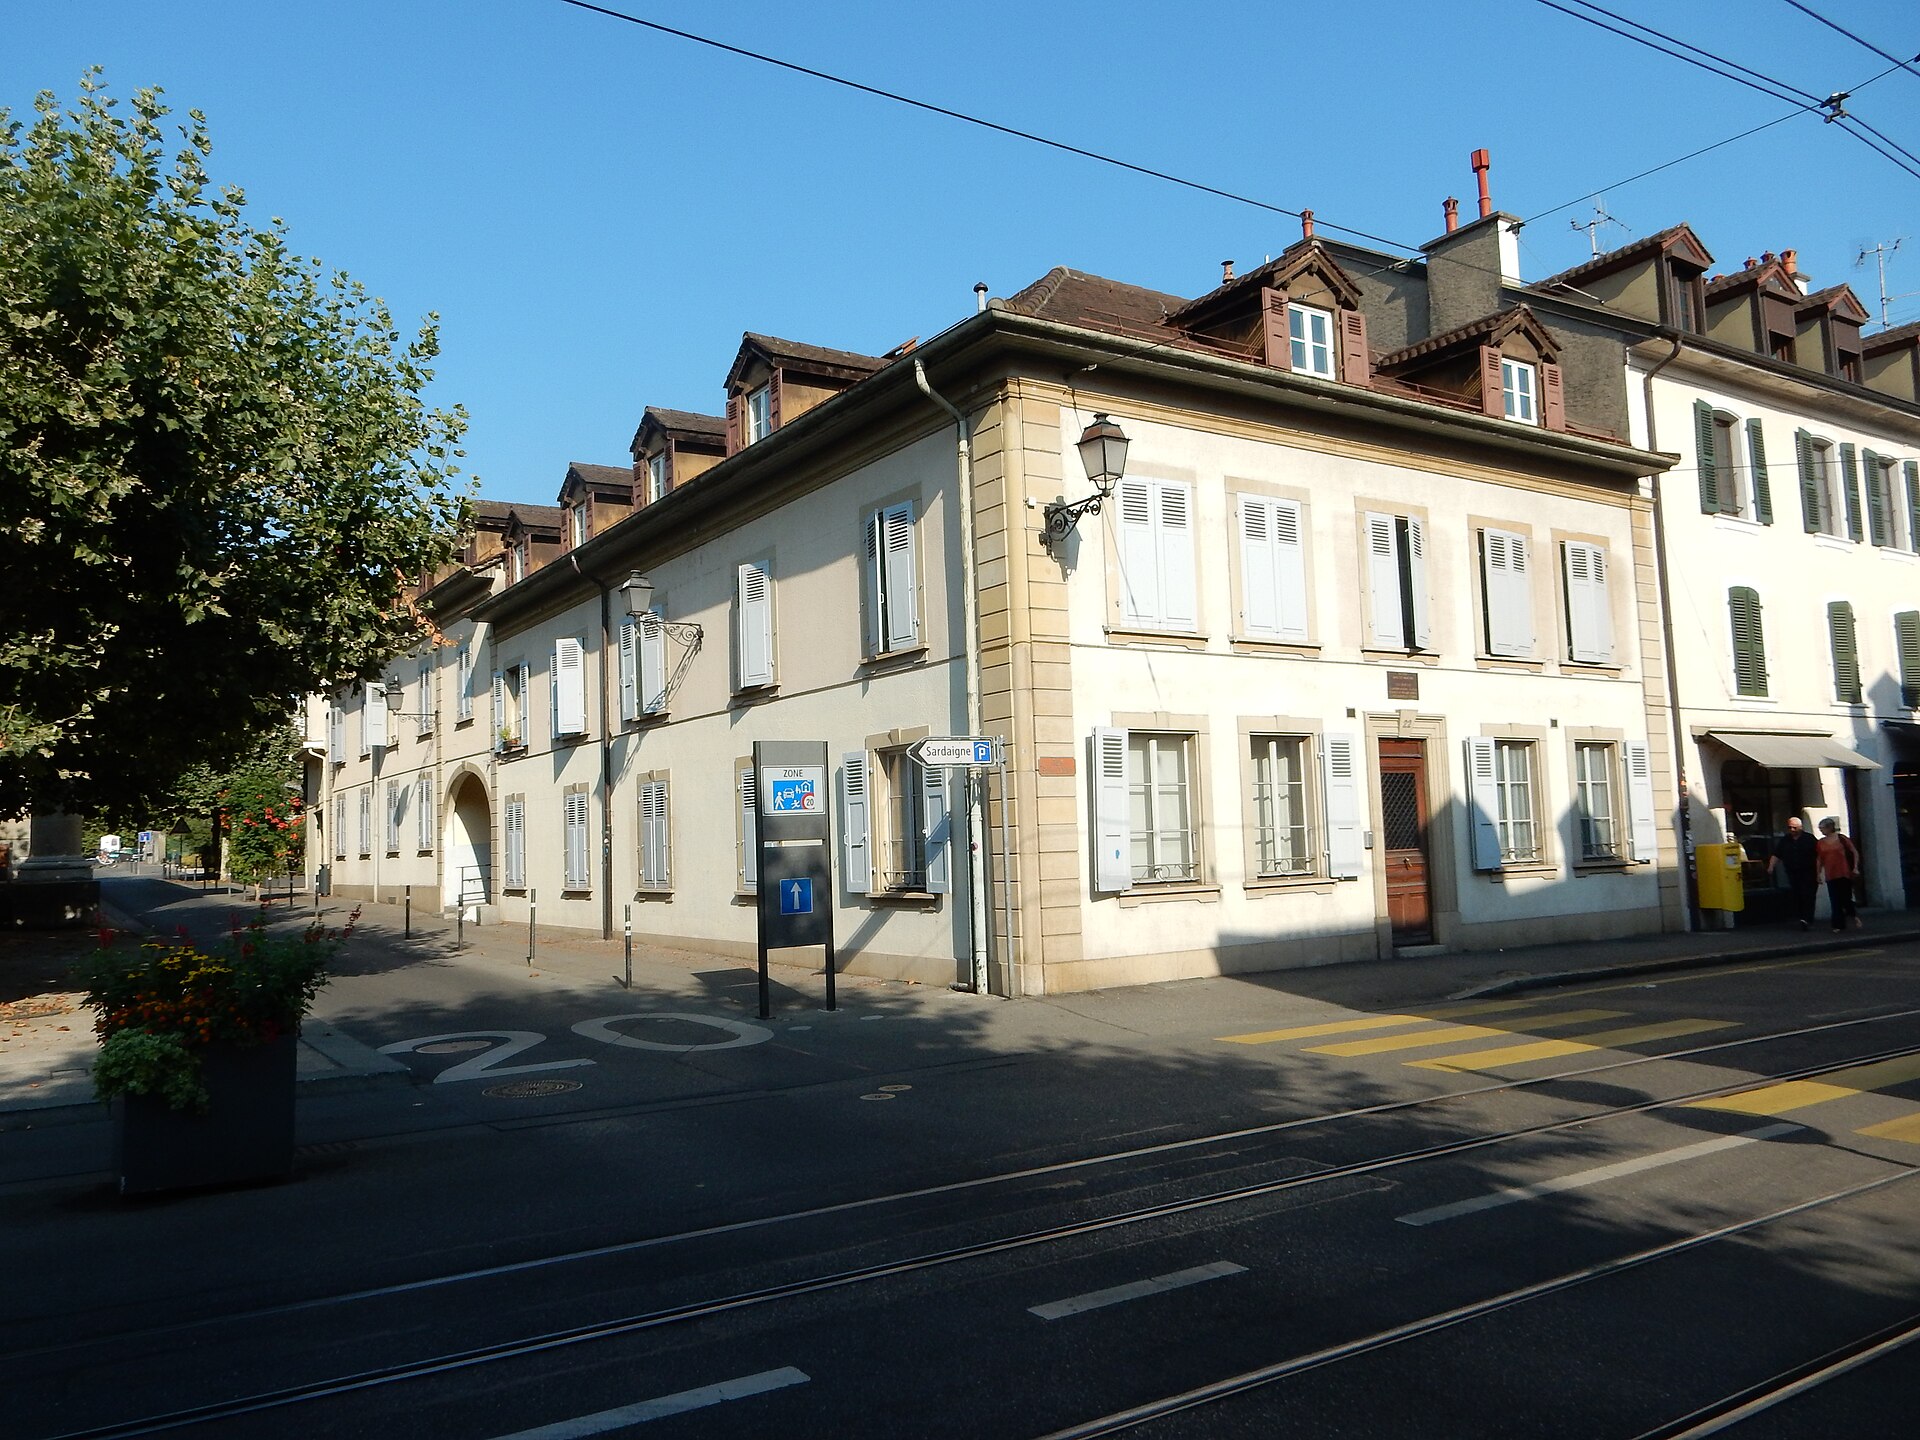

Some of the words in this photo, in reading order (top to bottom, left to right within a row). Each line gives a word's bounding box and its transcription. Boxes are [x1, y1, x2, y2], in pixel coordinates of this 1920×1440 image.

[1402, 719, 1412, 728] 22
[926, 746, 971, 758] Sardaigne
[978, 747, 986, 760] P
[783, 769, 804, 778] ZONE
[806, 798, 815, 807] 20
[376, 1012, 775, 1084] 20
